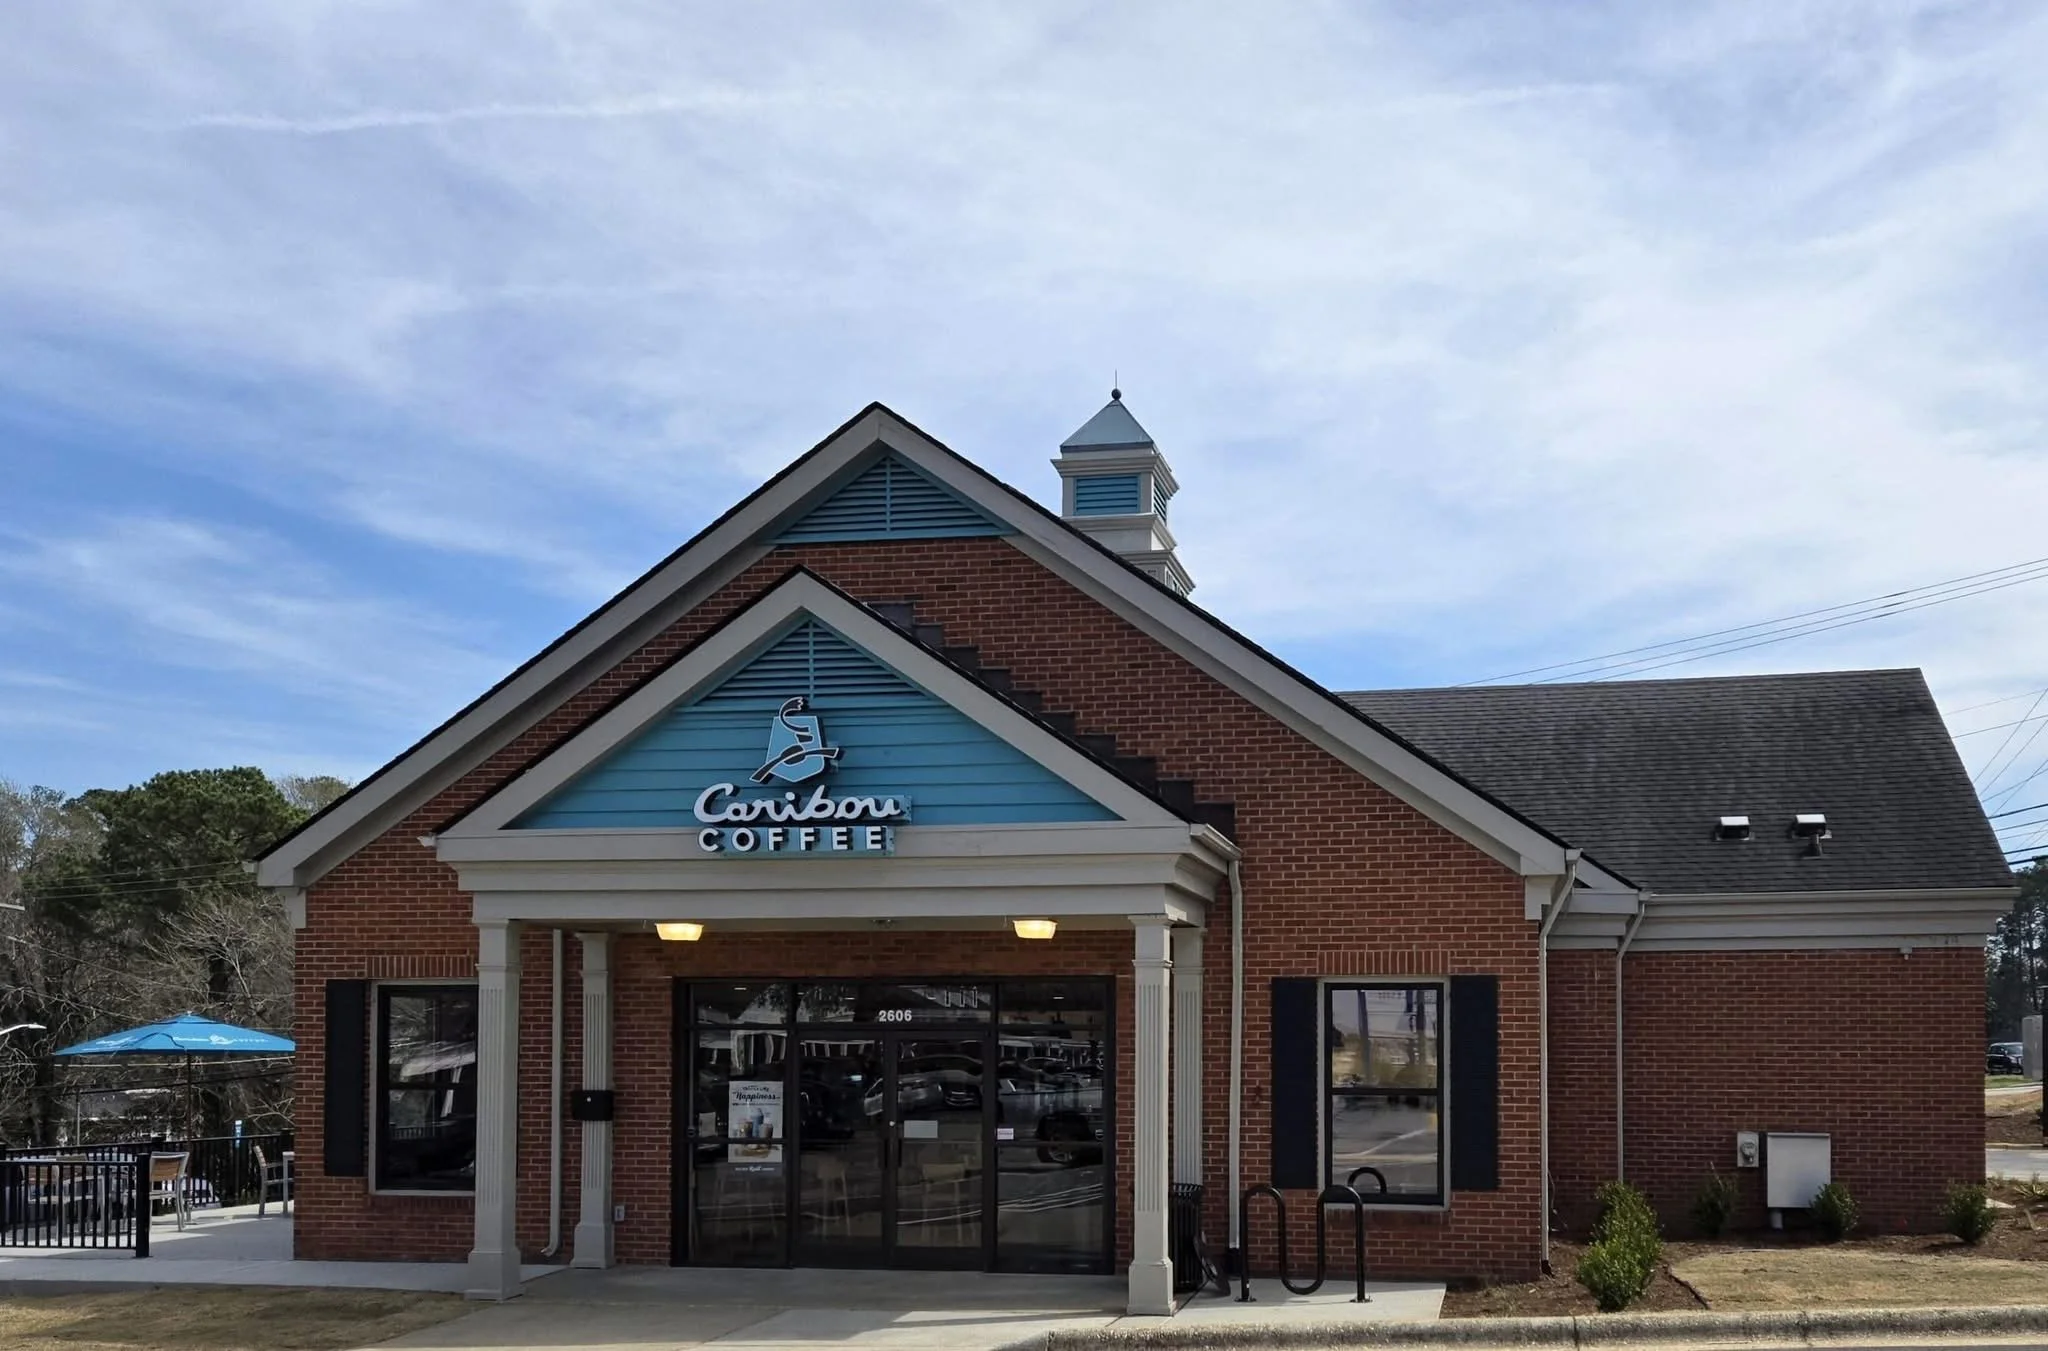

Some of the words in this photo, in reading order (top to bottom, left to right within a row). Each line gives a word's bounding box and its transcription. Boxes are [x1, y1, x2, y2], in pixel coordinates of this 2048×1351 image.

[694, 782, 901, 823] Caribou
[698, 826, 882, 852] COFFEE
[879, 1010, 912, 1022] 2606
[736, 1091, 776, 1102] Happiness
